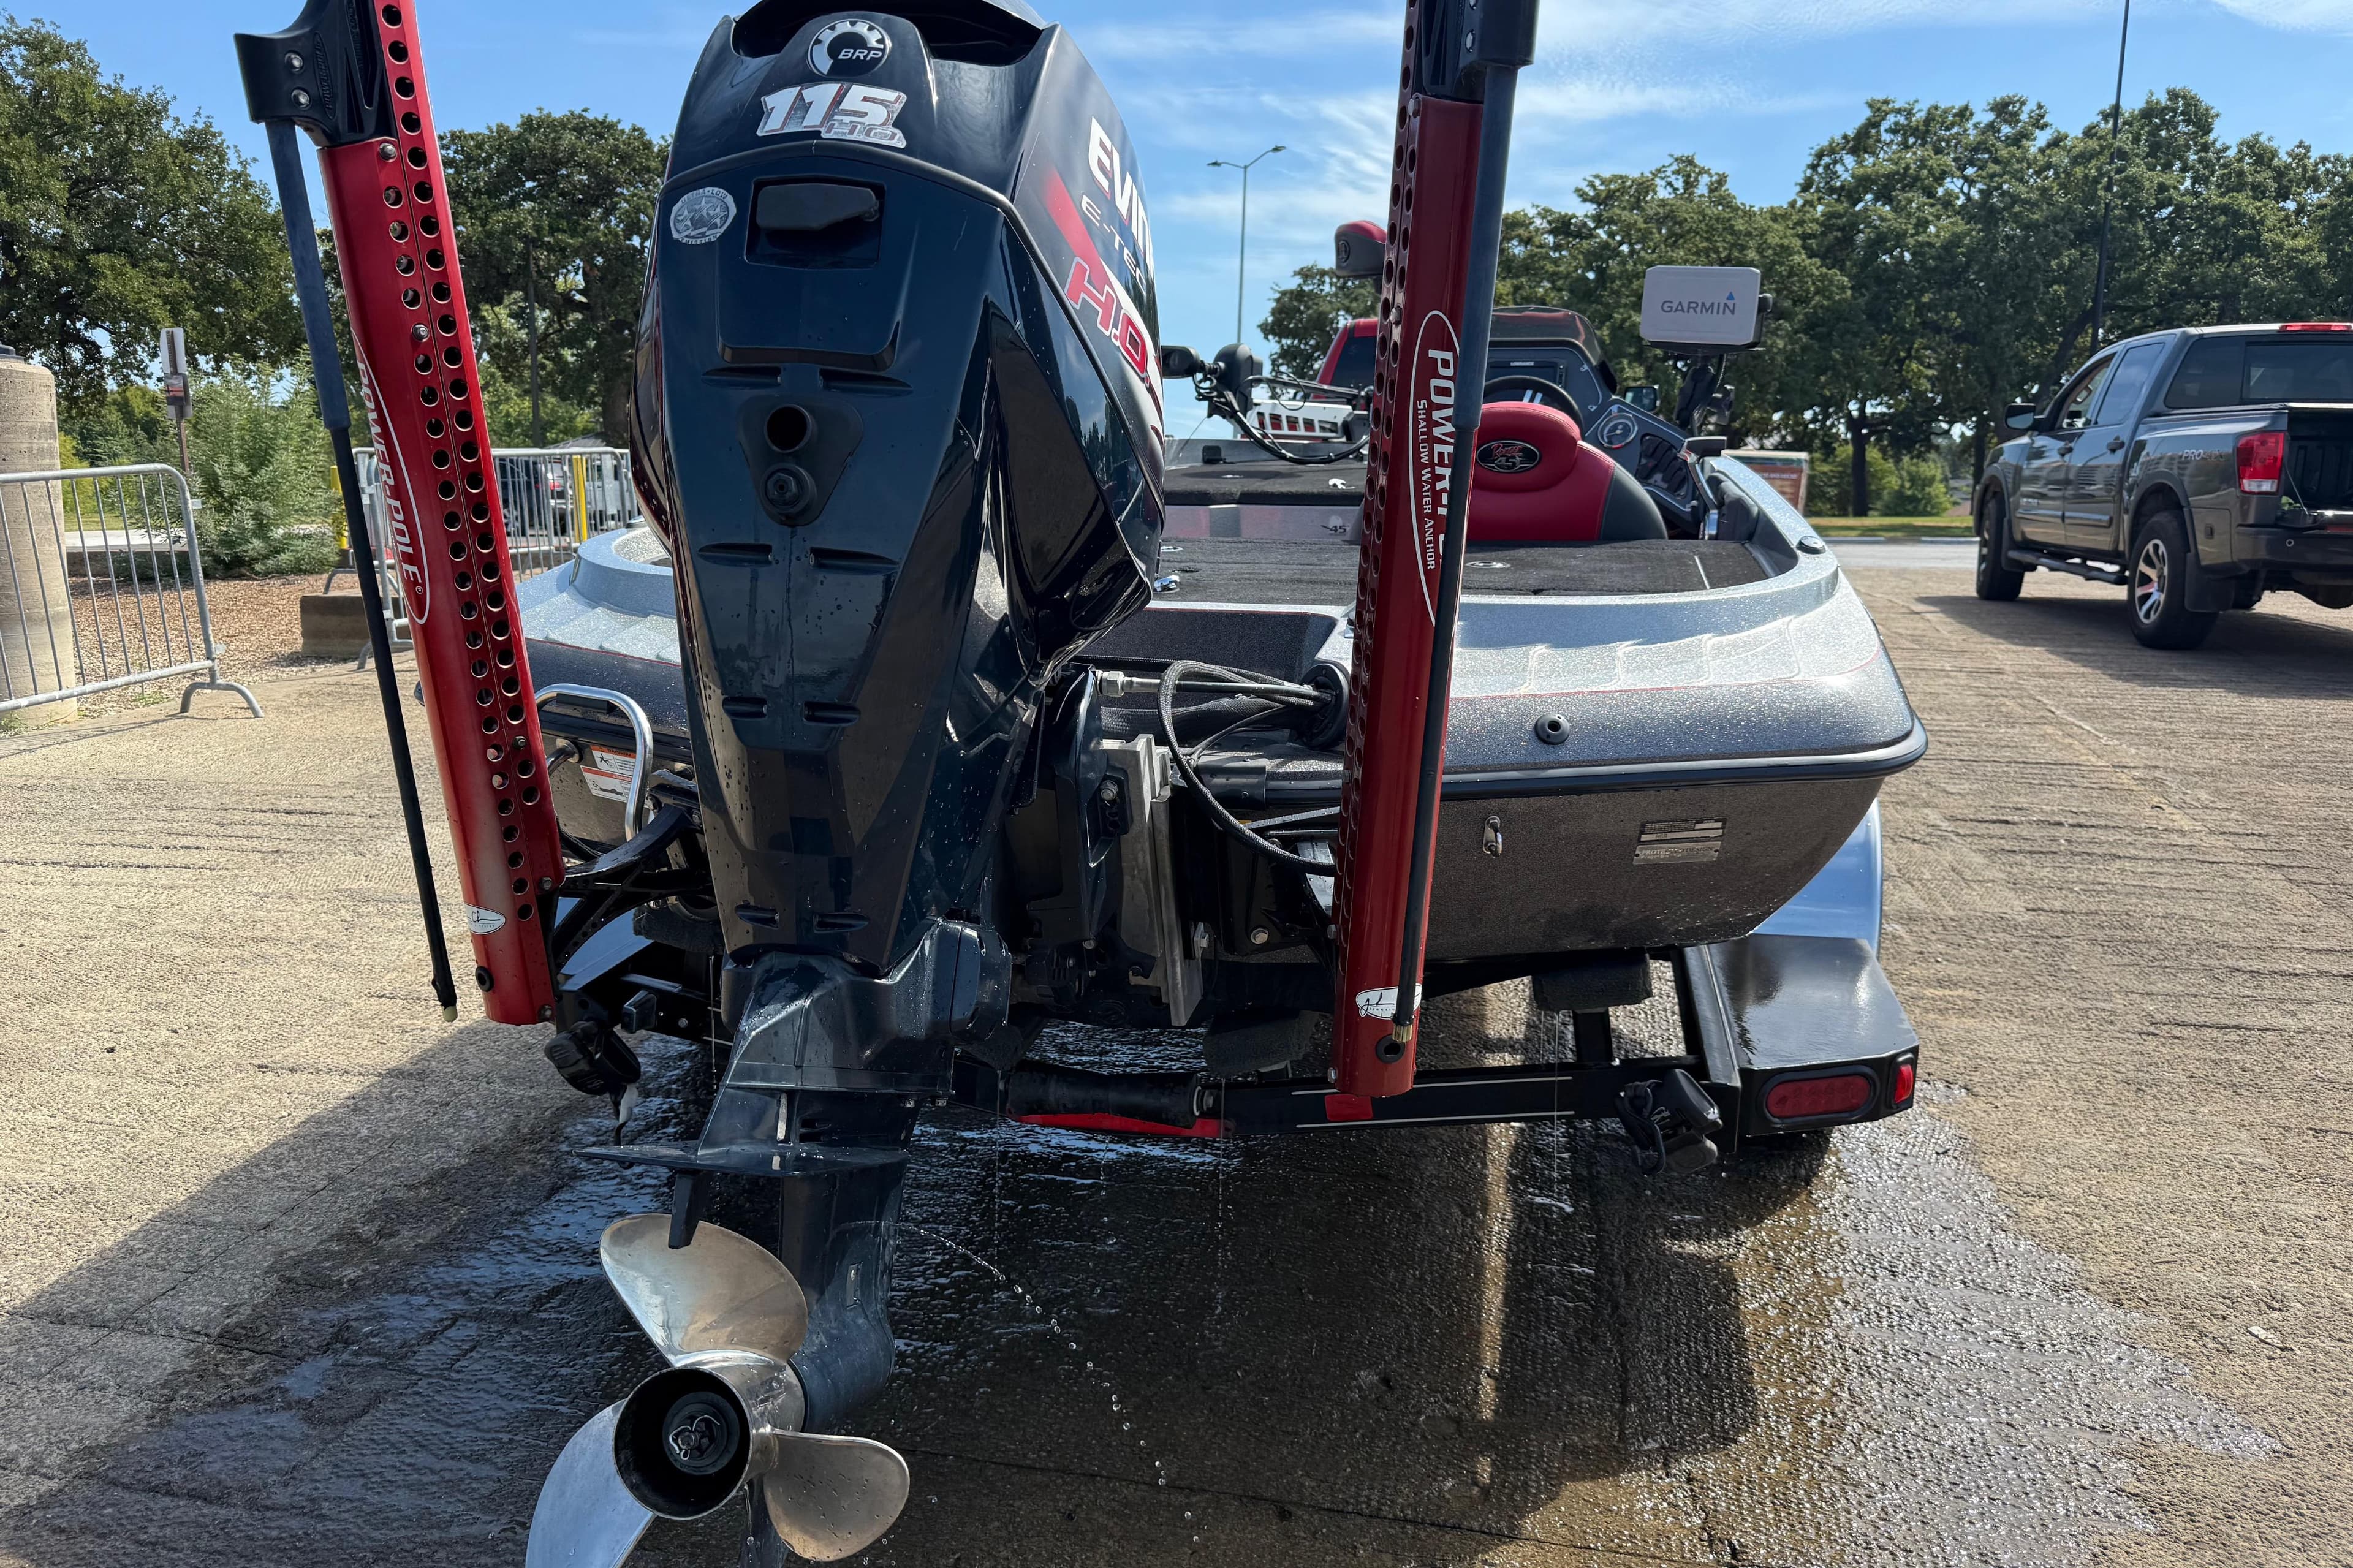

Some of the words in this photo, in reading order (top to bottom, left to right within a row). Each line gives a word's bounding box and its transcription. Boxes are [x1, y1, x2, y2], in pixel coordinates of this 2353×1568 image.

[838, 48, 882, 61] BRP
[765, 83, 902, 133] 115
[1660, 300, 1736, 316] GARMIN
[1417, 399, 1429, 463] SHALLOW
[358, 362, 423, 583] POWER-POLE
[1421, 467, 1432, 513] WATER
[1424, 518, 1436, 569] ANCHOR
